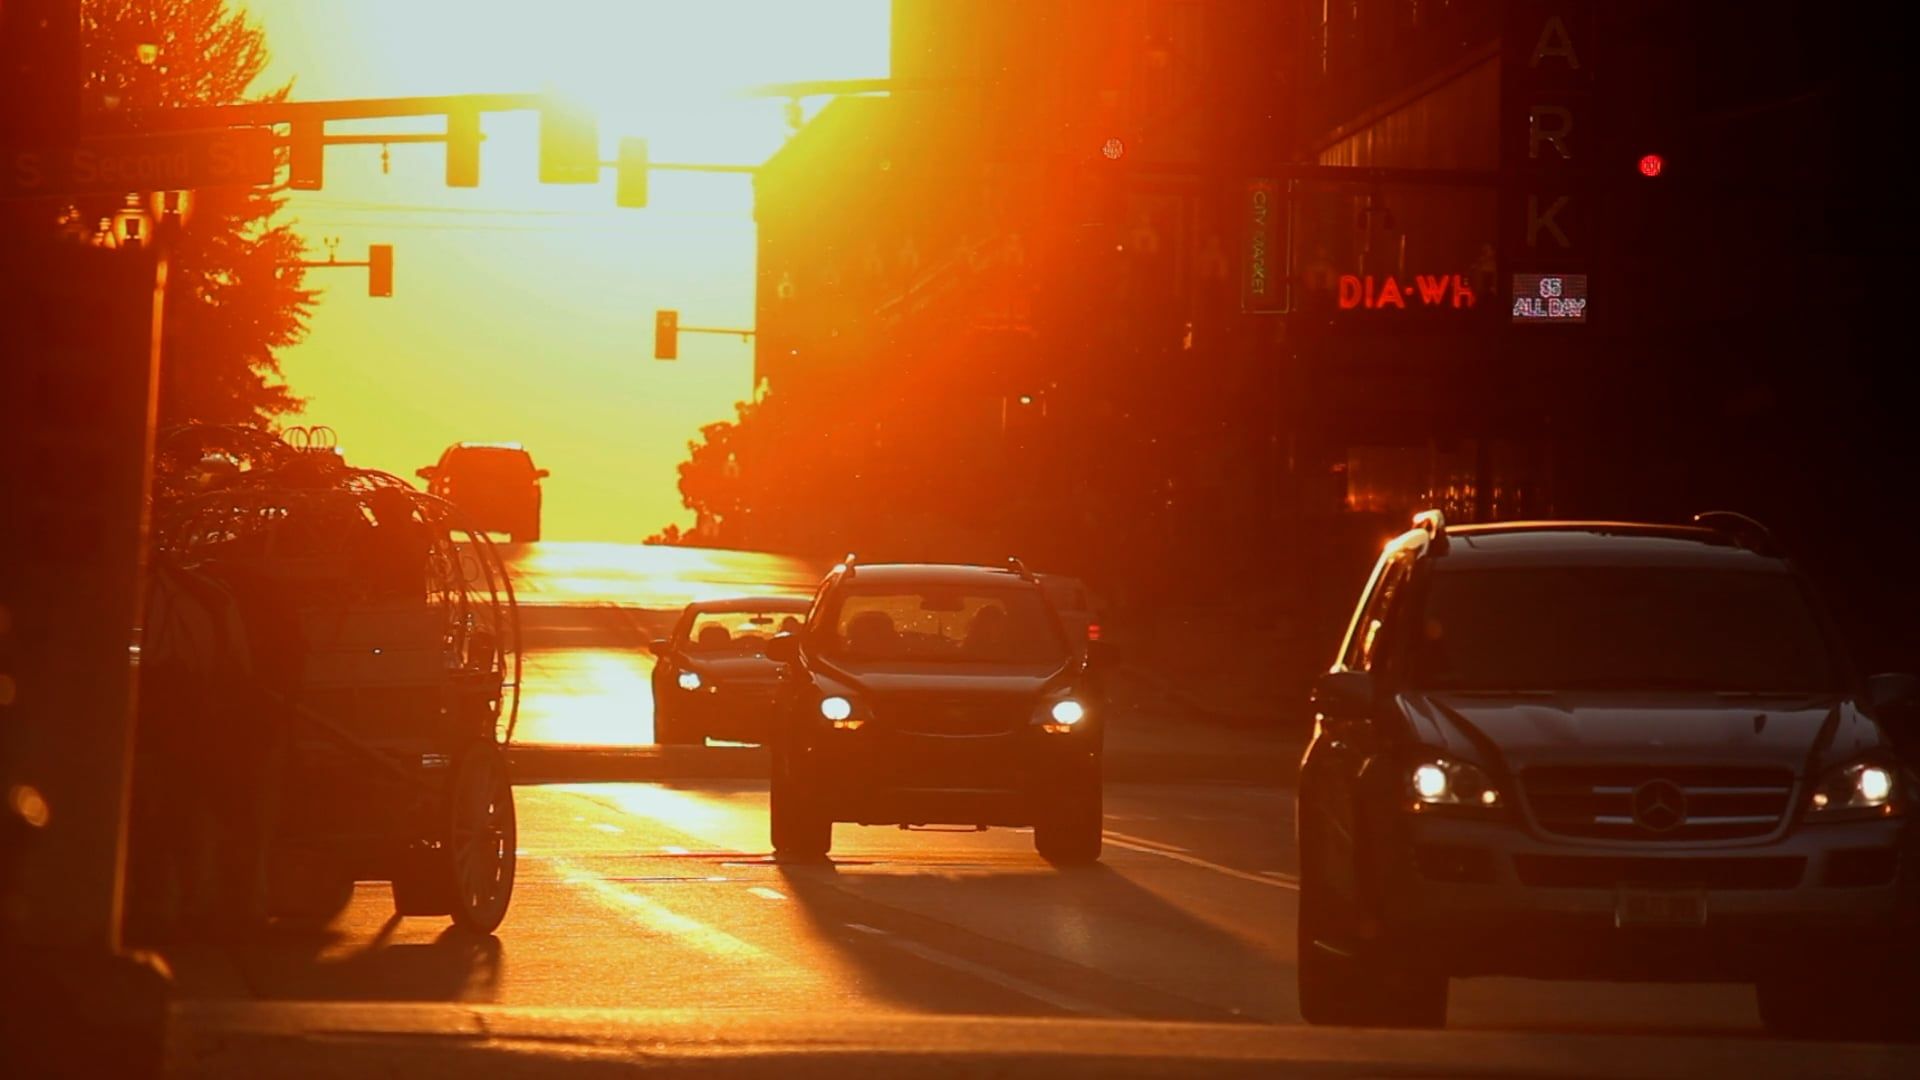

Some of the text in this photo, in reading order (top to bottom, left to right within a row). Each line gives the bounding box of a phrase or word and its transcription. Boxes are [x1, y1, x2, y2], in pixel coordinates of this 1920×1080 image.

[16, 151, 41, 188] S
[73, 146, 189, 183] Second
[1540, 278, 1562, 298] $5
[1512, 297, 1586, 317] ALL DAY
